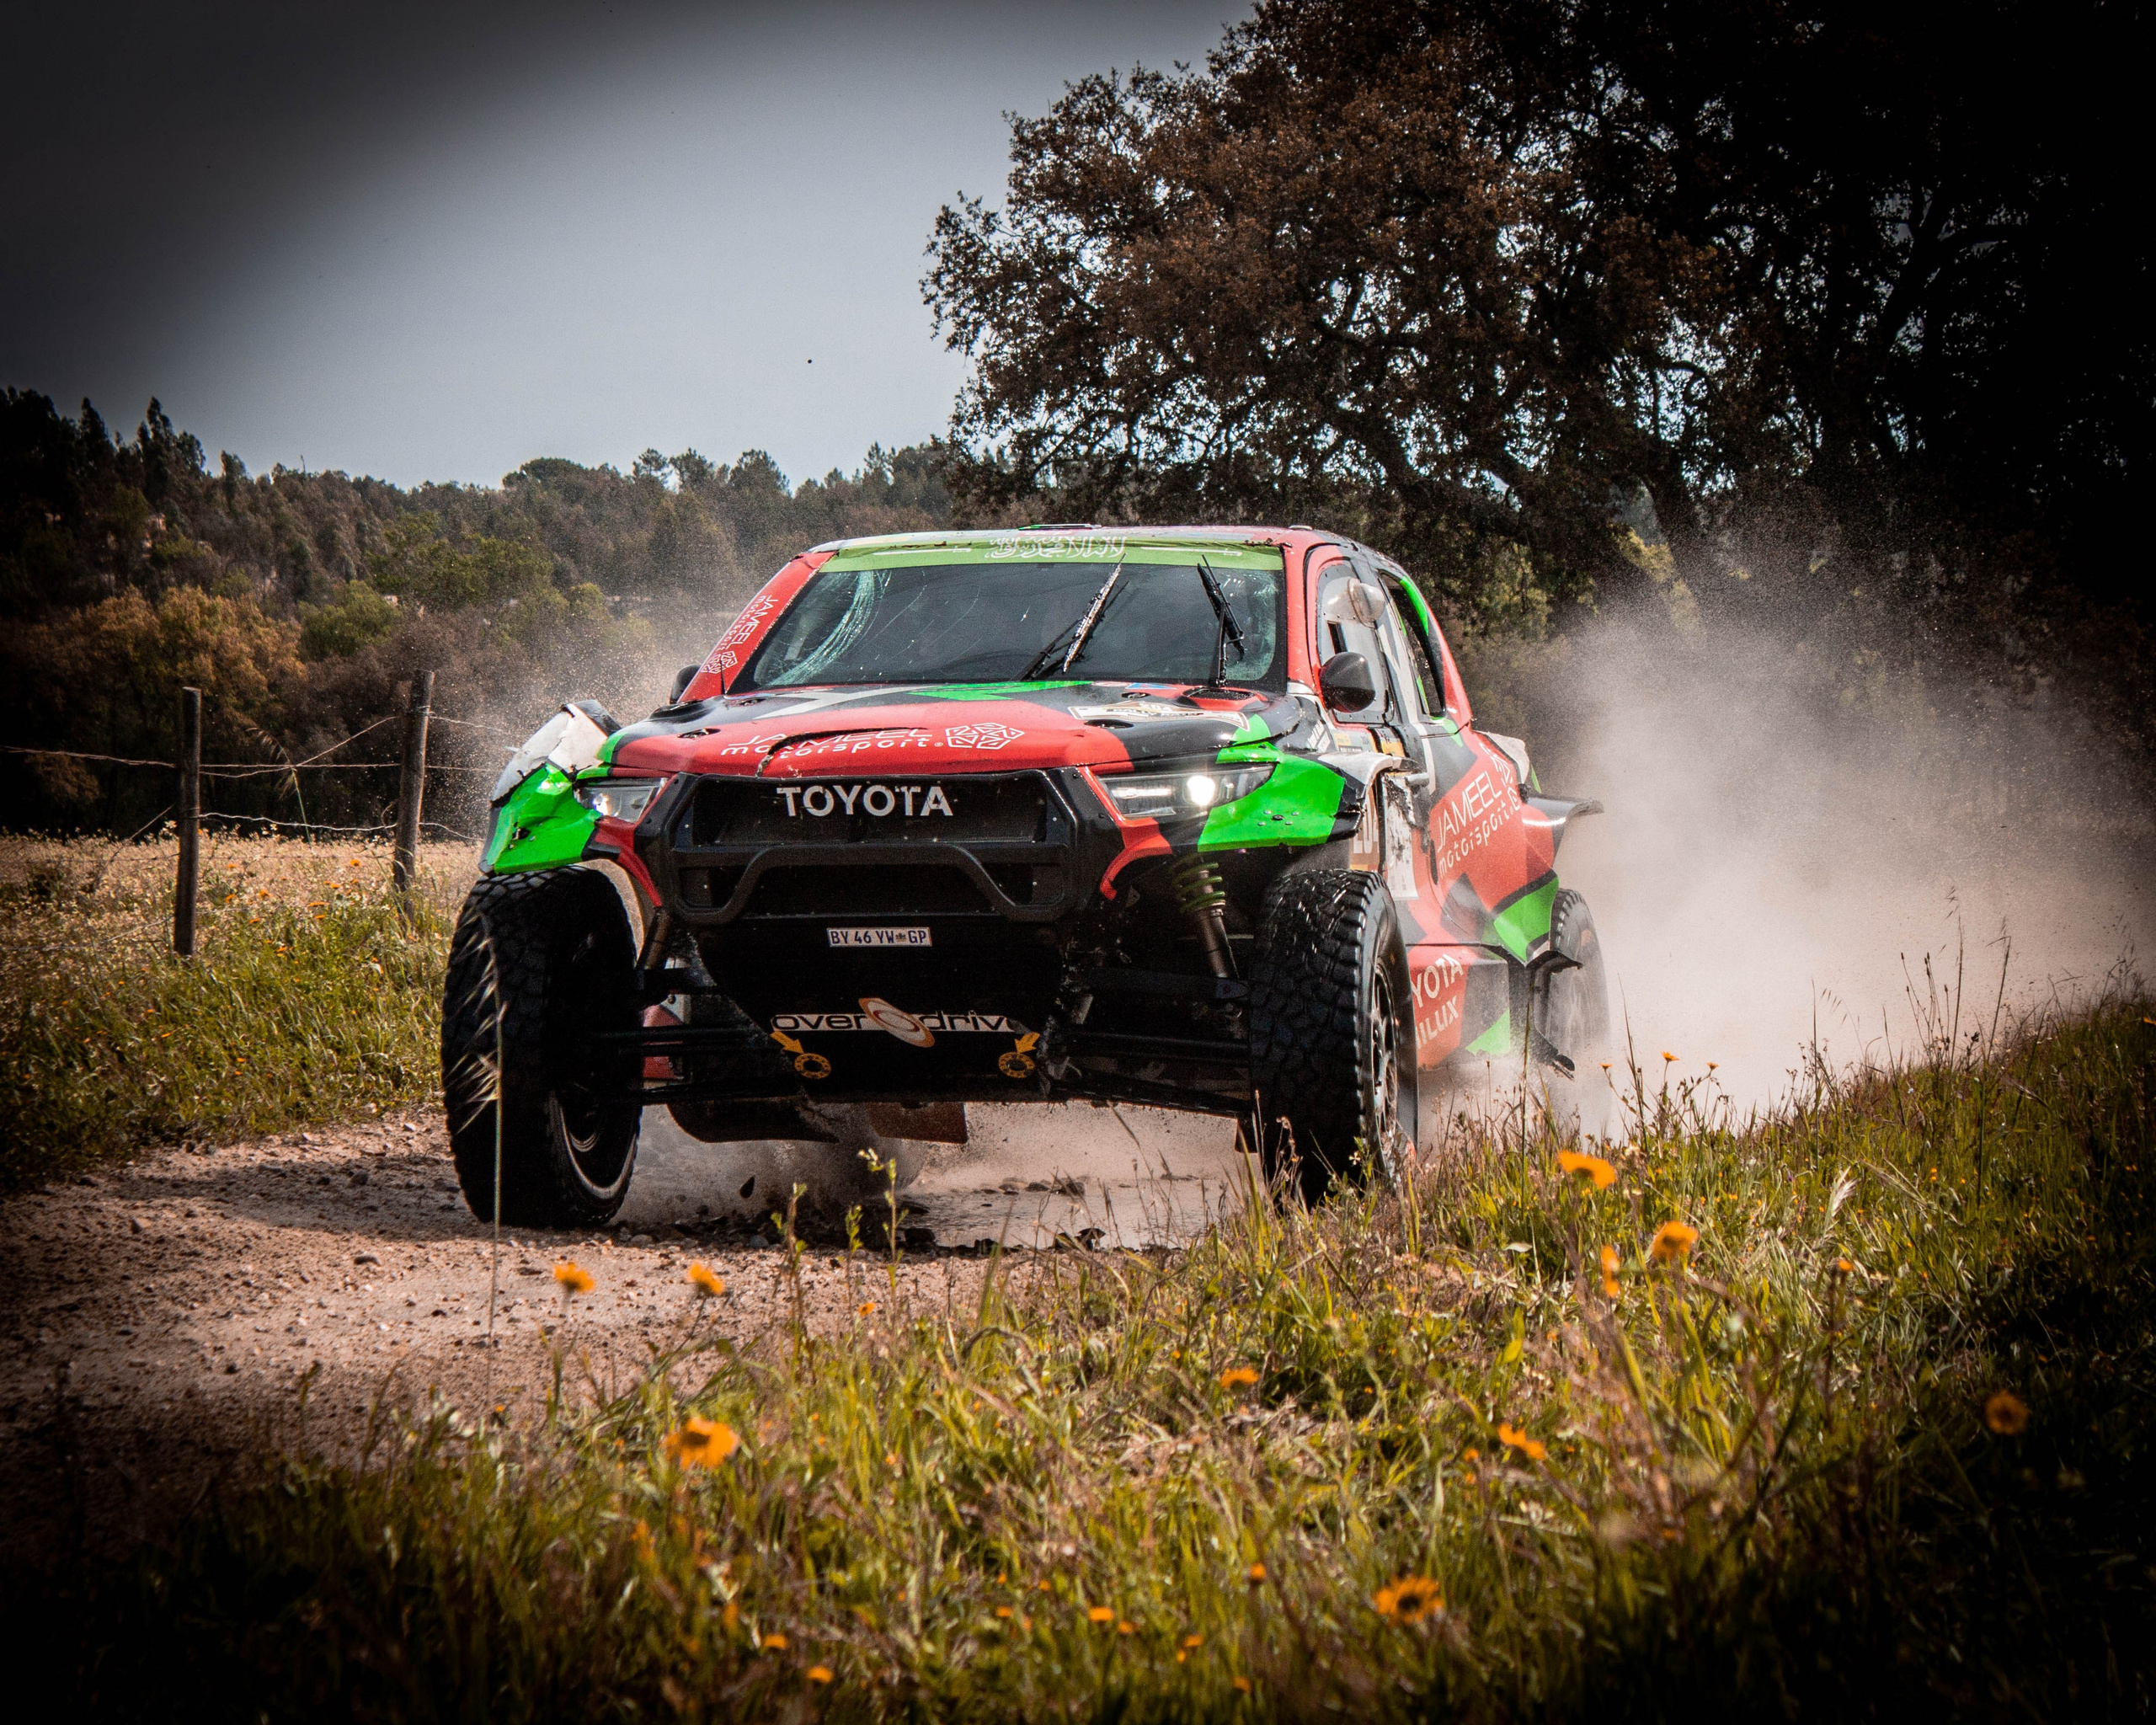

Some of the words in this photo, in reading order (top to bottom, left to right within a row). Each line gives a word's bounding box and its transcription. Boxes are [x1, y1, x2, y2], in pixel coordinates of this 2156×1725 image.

[715, 595, 766, 651] motorsport
[725, 595, 778, 649] JAMEEL
[776, 784, 953, 816] TOYOTA
[1438, 771, 1502, 853] JAMEEL
[1439, 800, 1510, 879] motorsport
[830, 931, 849, 944] BY
[854, 931, 873, 944] 46
[875, 930, 894, 944] YW
[907, 930, 927, 944] GP
